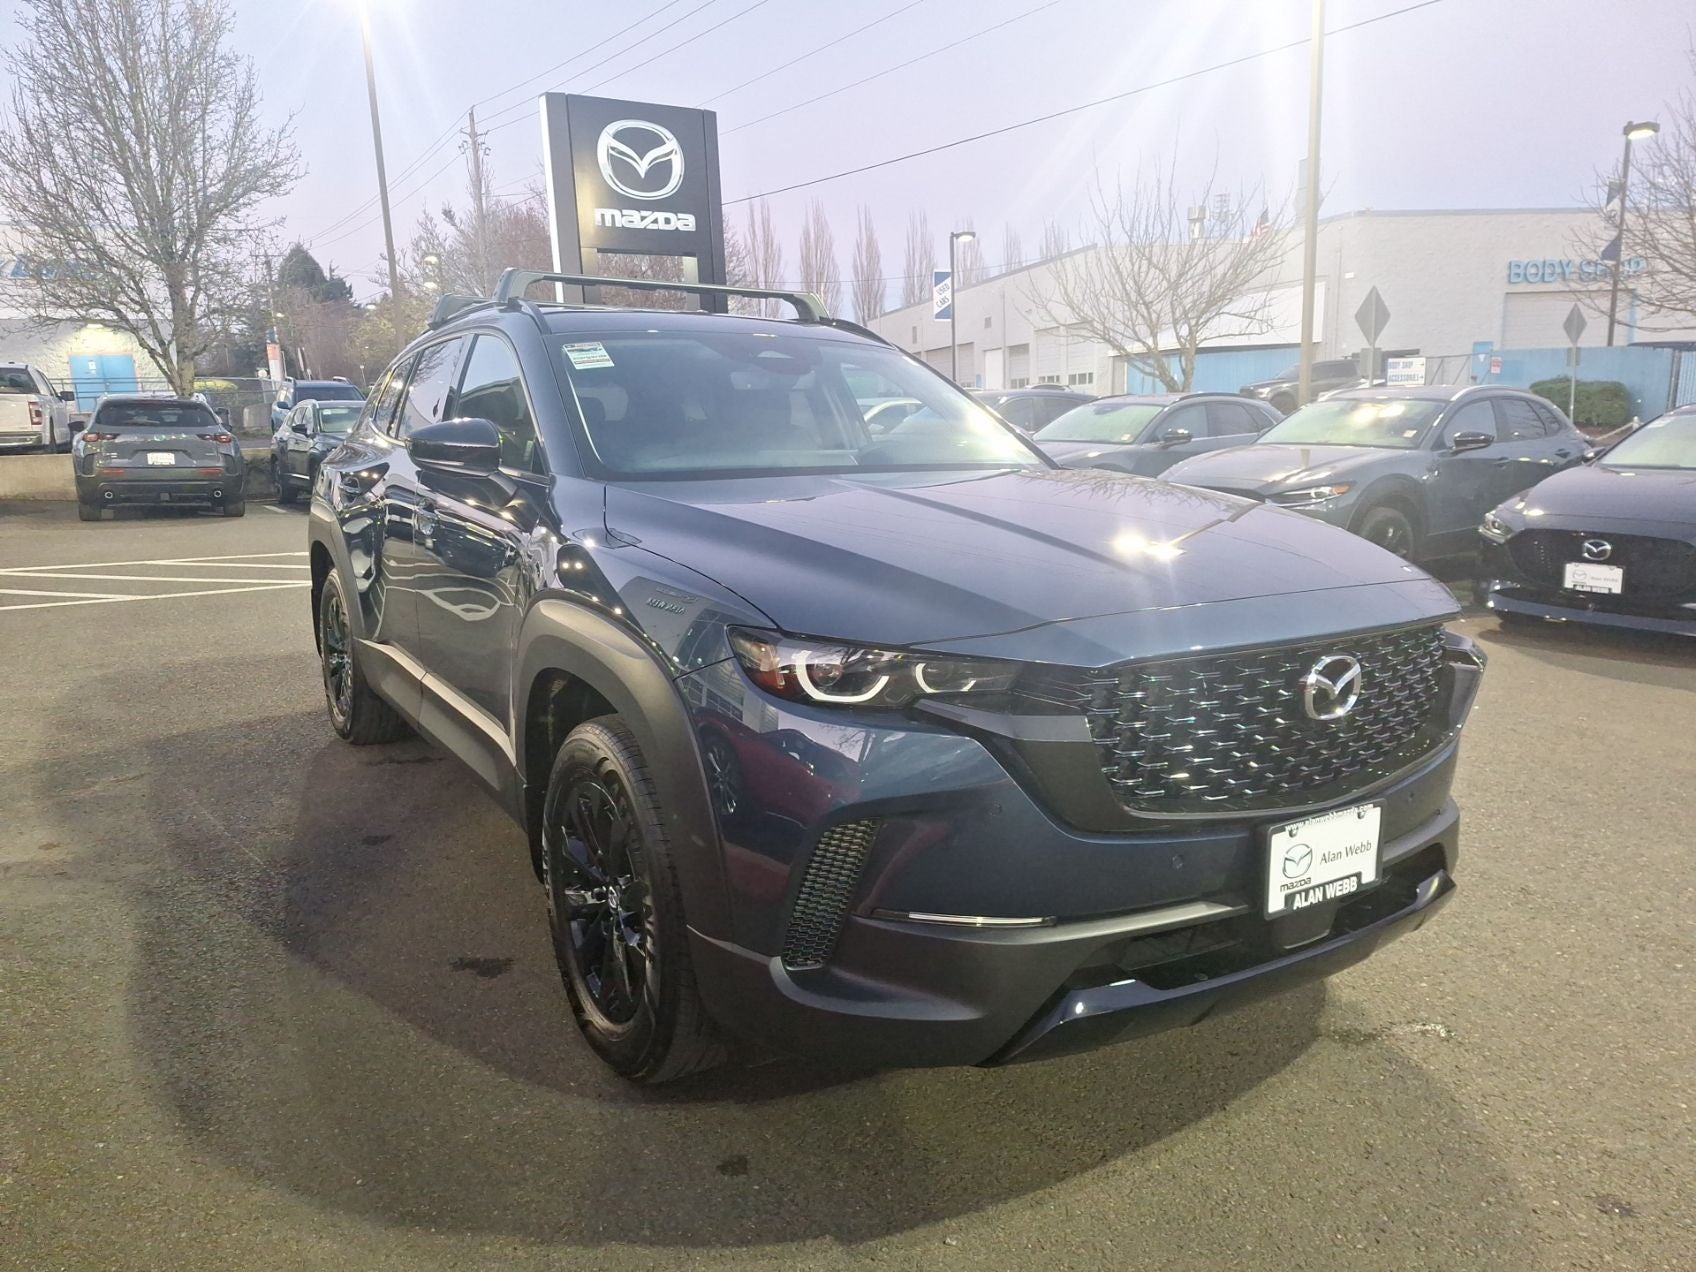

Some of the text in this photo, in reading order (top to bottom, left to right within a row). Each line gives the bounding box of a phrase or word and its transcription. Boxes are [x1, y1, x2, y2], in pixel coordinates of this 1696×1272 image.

[595, 208, 696, 231] mazda
[1508, 260, 1572, 284] BODY
[936, 283, 950, 296] USED
[936, 295, 950, 308] CARS
[1320, 840, 1372, 864] Alan Webb
[1280, 877, 1311, 892] mazda
[1293, 876, 1358, 910] ALAN WEBB
